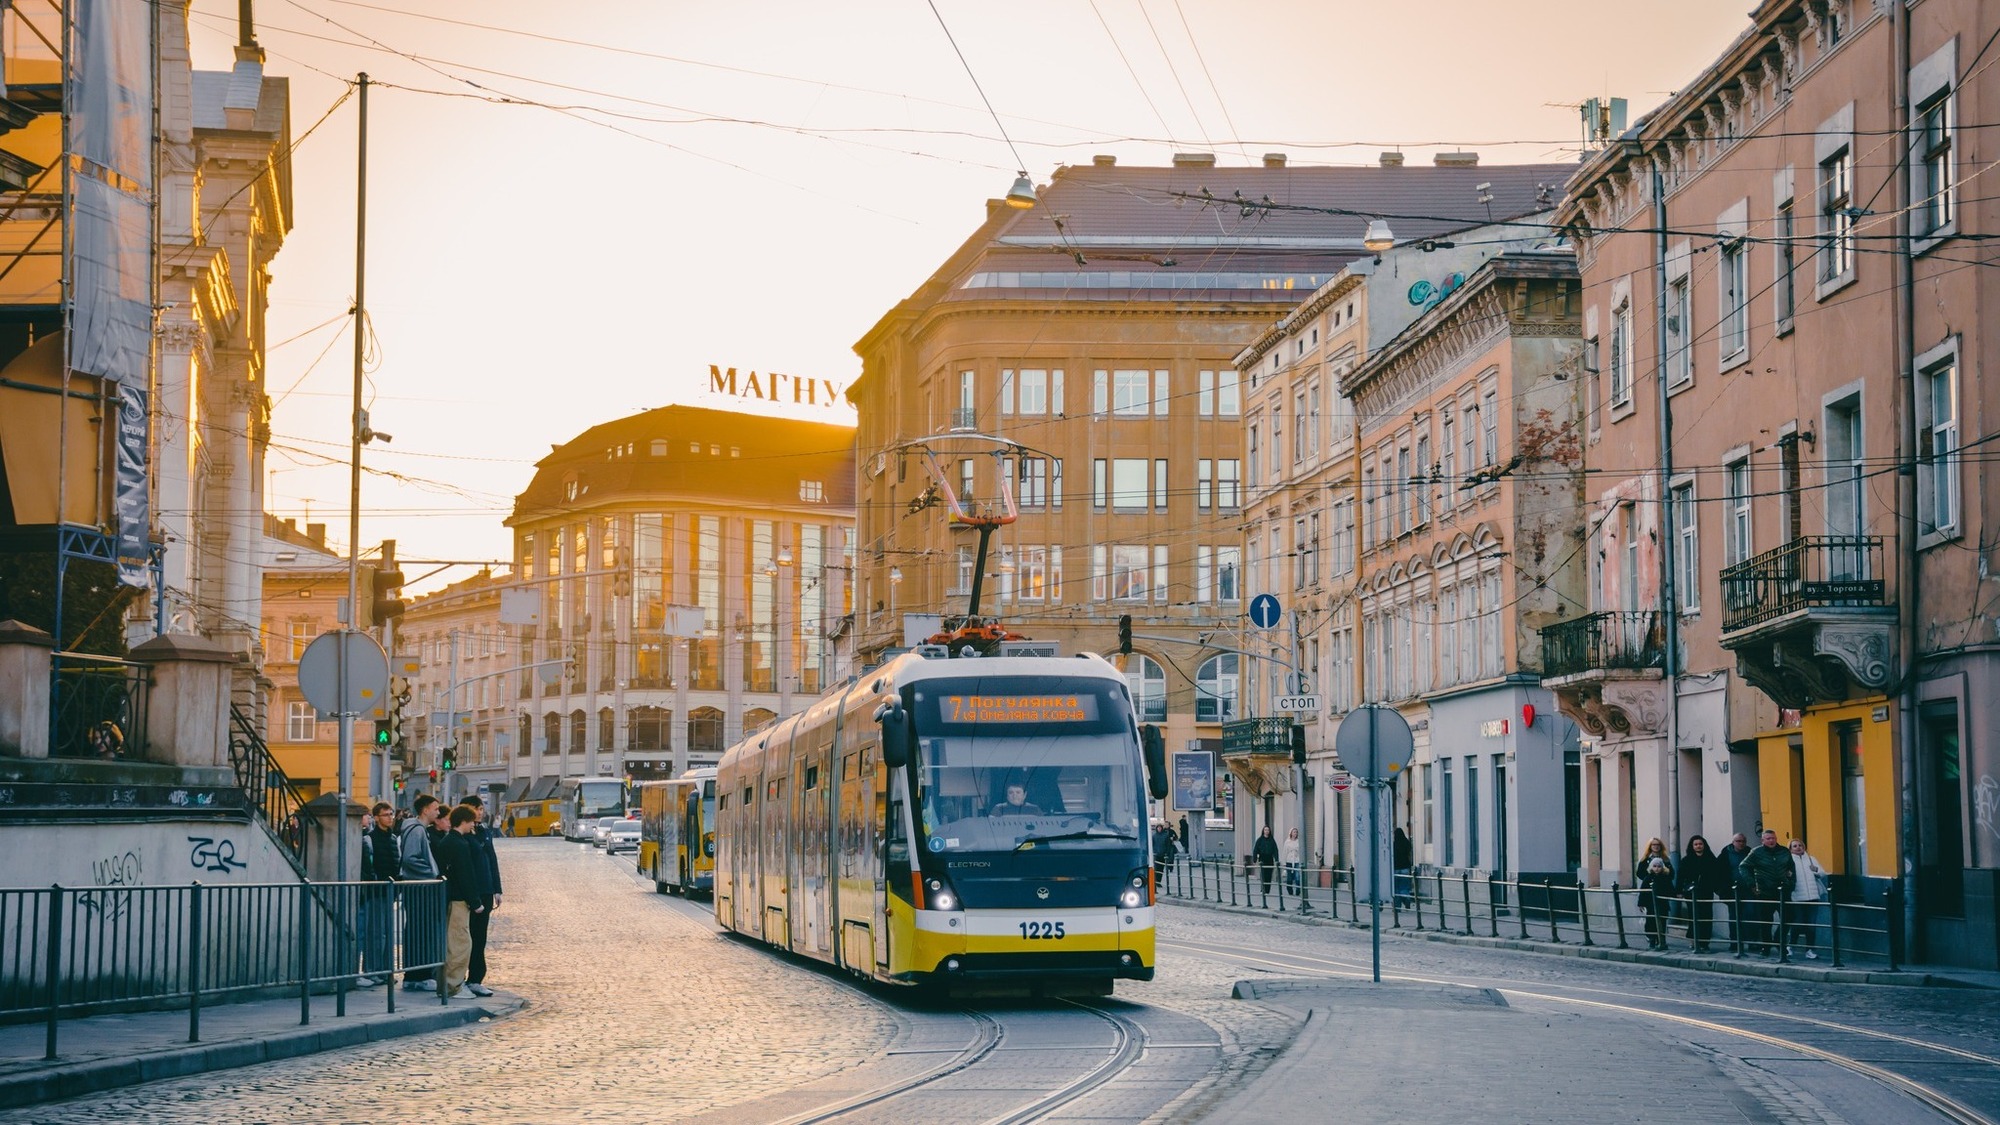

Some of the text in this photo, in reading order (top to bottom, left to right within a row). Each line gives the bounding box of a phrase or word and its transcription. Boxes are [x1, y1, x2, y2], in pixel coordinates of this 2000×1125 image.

[1807, 585, 1824, 594] ву.
[950, 696, 1077, 720] 7 Погулянка
[1280, 697, 1315, 709] СТОП
[948, 861, 991, 869] ELECTRON
[1019, 921, 1066, 940] 1225
